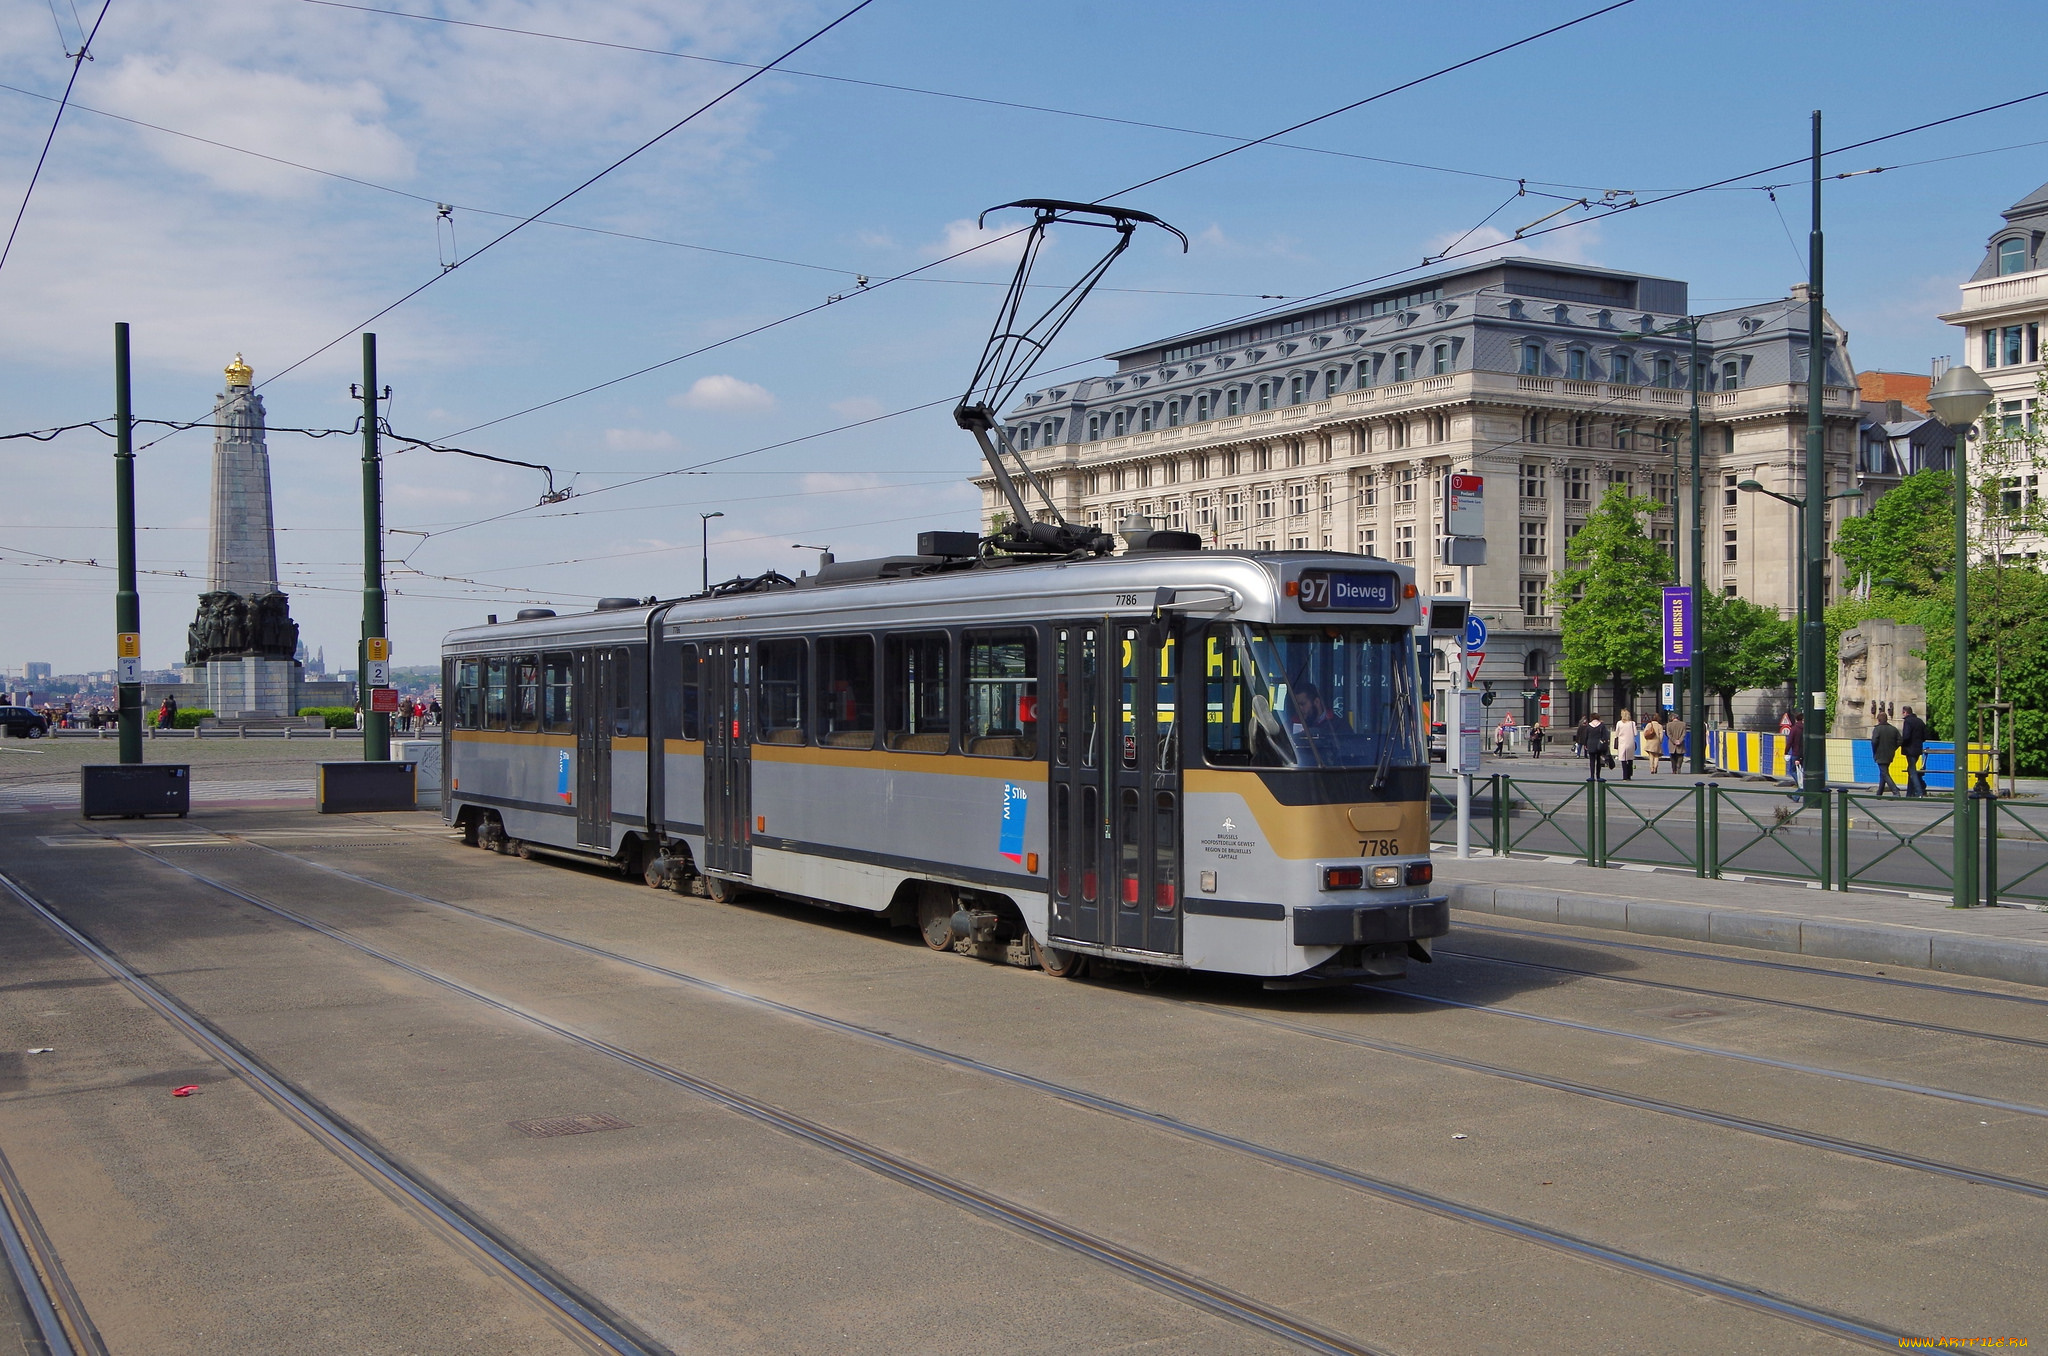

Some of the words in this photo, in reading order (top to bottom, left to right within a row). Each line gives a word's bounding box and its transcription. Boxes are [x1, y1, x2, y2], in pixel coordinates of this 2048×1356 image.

[1301, 579, 1328, 602] 97
[1336, 583, 1386, 601] Dieweg
[1115, 594, 1137, 606] 7786
[1672, 599, 1683, 637] BRUSSELS
[1673, 639, 1683, 654] ART
[127, 665, 133, 675] 1
[375, 669, 382, 678] 2
[1358, 839, 1399, 857] 7786
